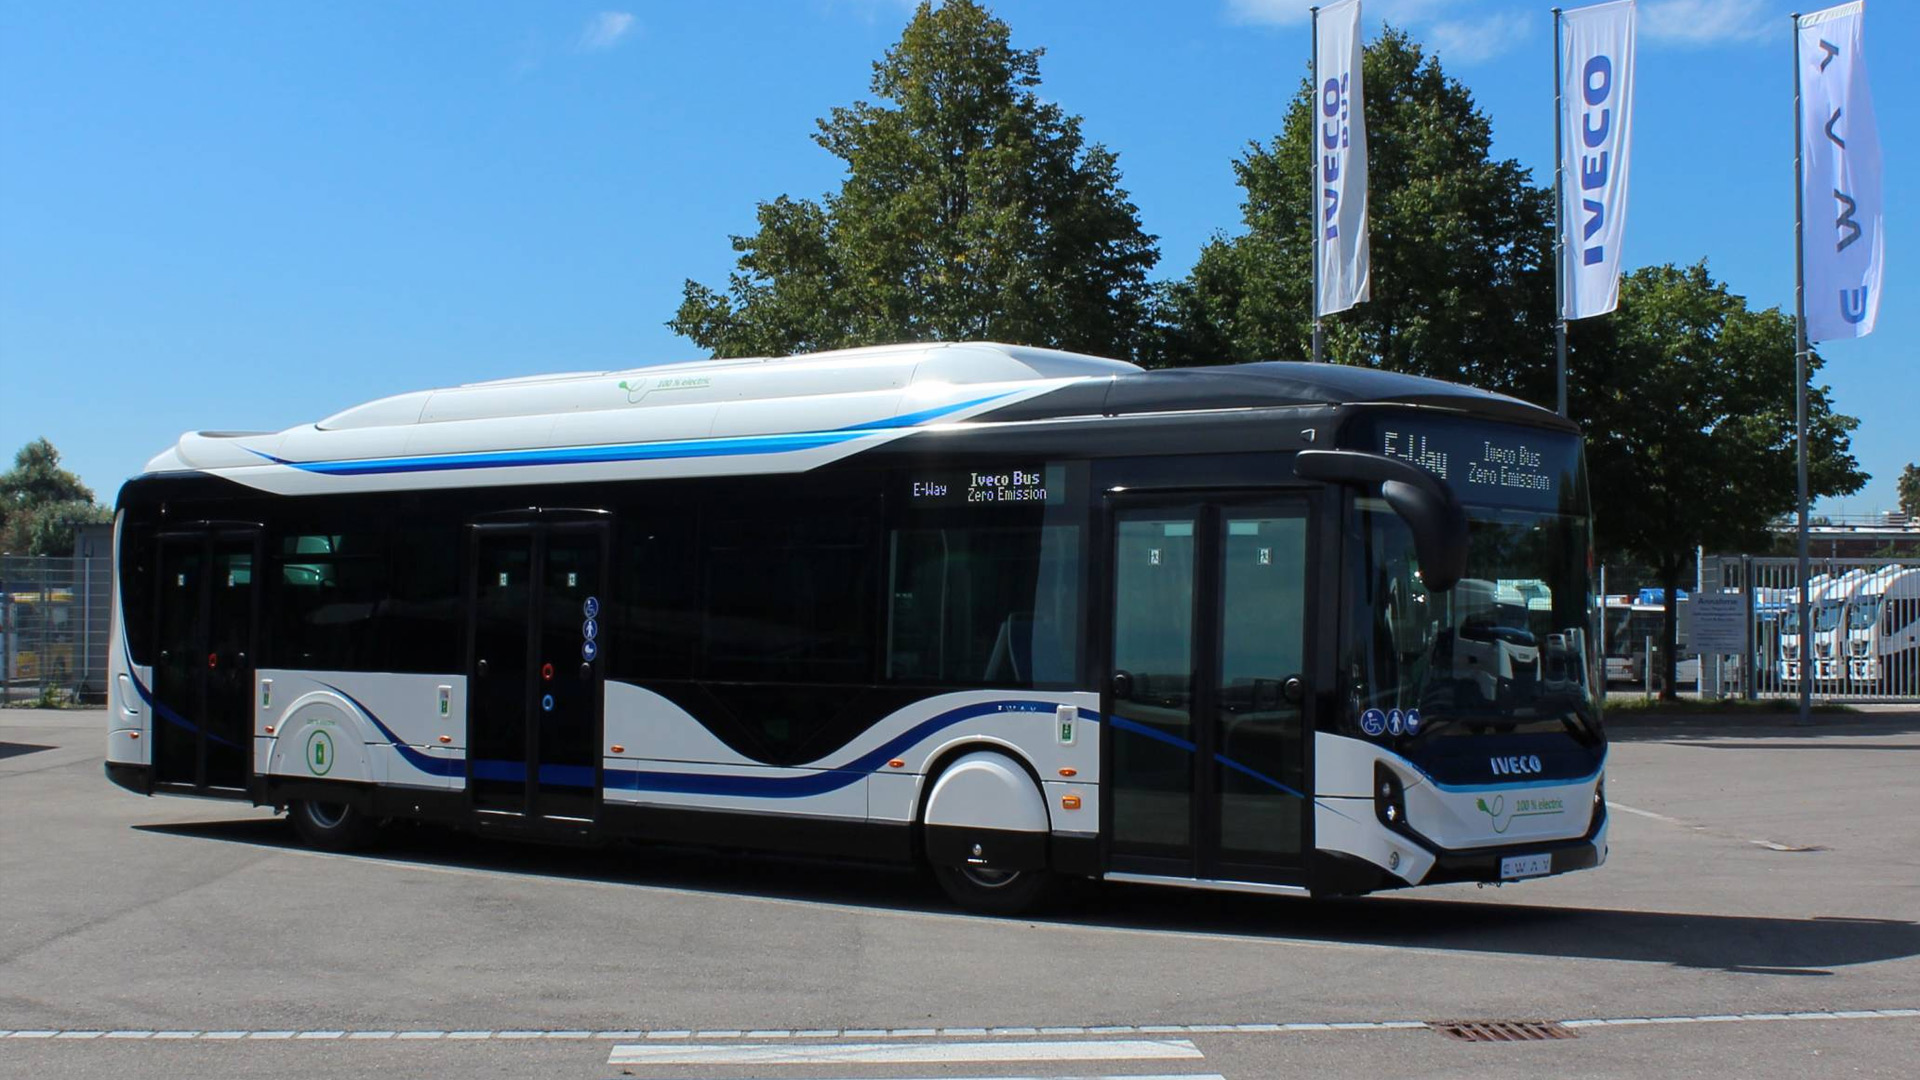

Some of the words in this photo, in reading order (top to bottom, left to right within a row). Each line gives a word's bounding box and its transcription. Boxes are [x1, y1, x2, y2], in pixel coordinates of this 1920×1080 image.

[1322, 77, 1341, 241] IVECO
[1581, 54, 1613, 267] IVECO
[1484, 441, 1516, 465] Iveco
[1519, 445, 1541, 468] Bus
[970, 472, 1009, 488] Iveco
[1012, 470, 1041, 486] Bus
[1468, 461, 1497, 485] Zero
[1500, 465, 1550, 491] Emission
[913, 482, 948, 498] E-Way
[967, 487, 994, 502] Zero
[997, 485, 1047, 502] Emission
[1490, 754, 1543, 776] IVECO
[1516, 799, 1530, 812] 100
[1538, 796, 1564, 810] electric
